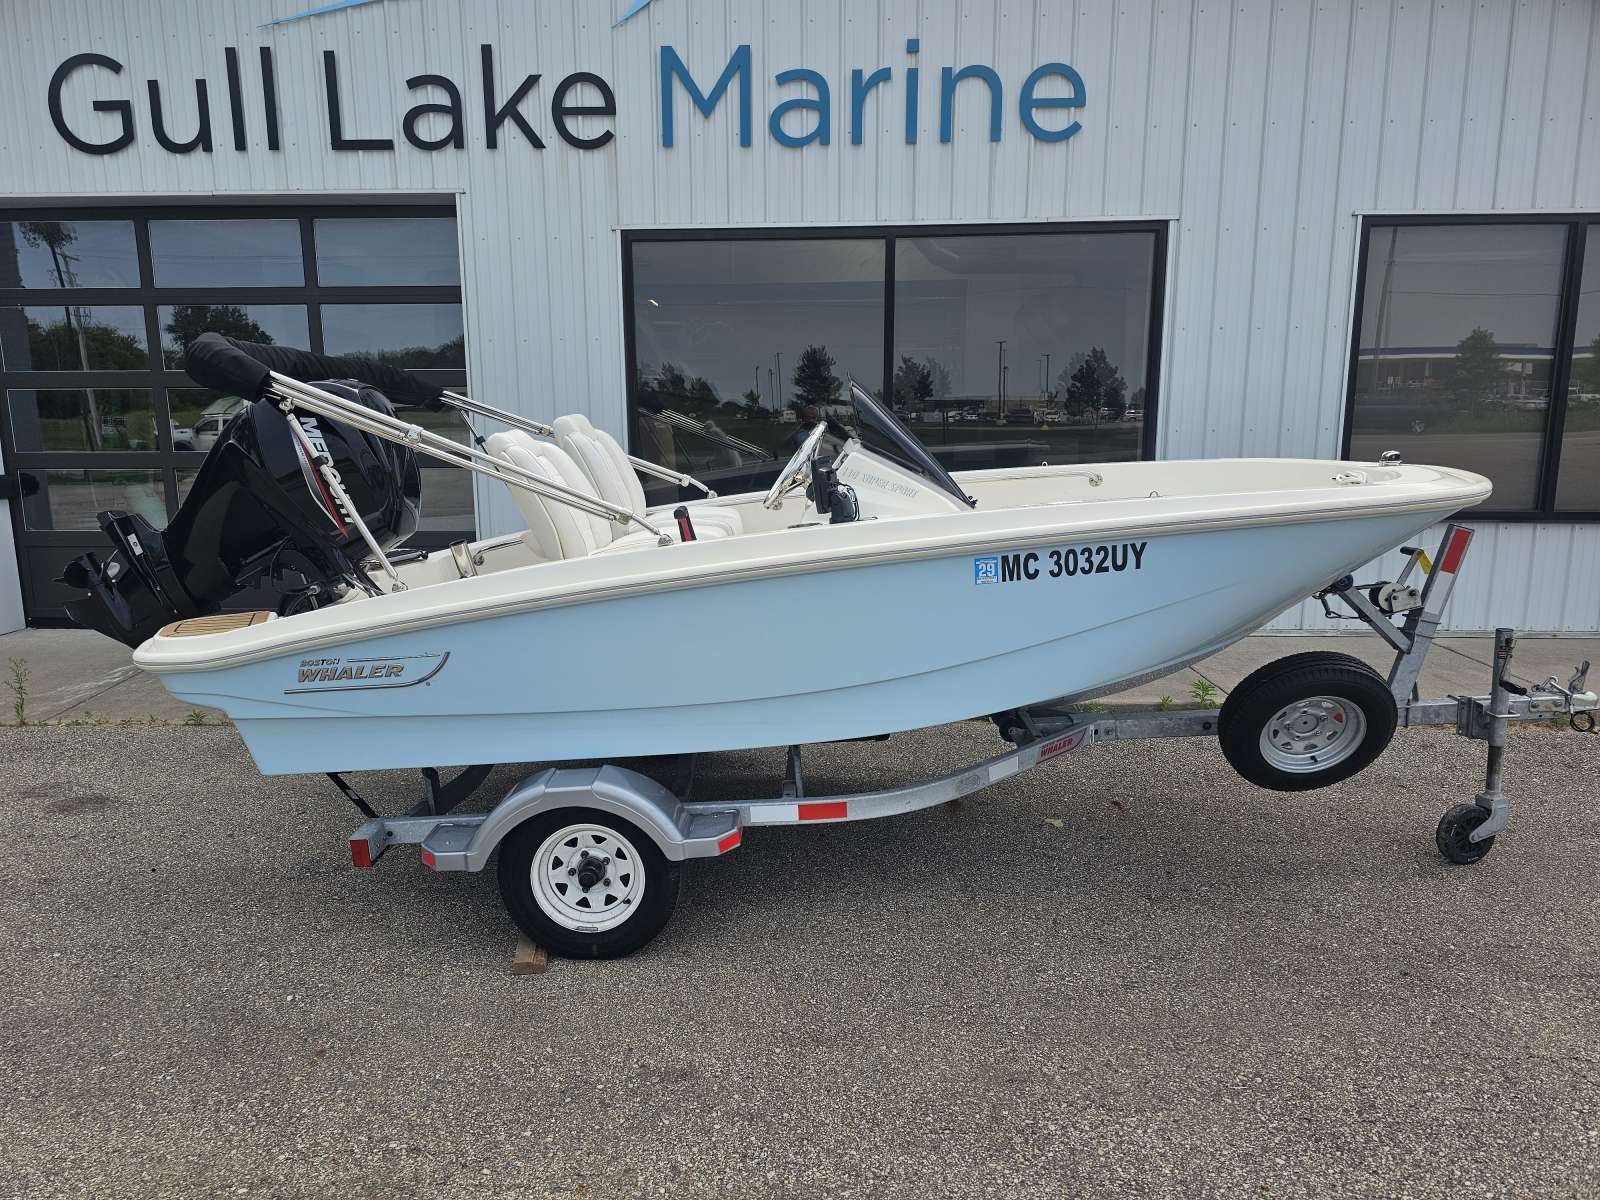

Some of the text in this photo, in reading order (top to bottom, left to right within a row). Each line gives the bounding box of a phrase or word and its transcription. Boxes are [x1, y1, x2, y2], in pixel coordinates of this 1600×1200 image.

[48, 38, 1087, 155] Gull Lake Marine
[978, 562, 996, 577] 29
[1001, 541, 1148, 582] MC 3032UY
[300, 657, 341, 668] BOSTON
[298, 664, 404, 683] WHALER
